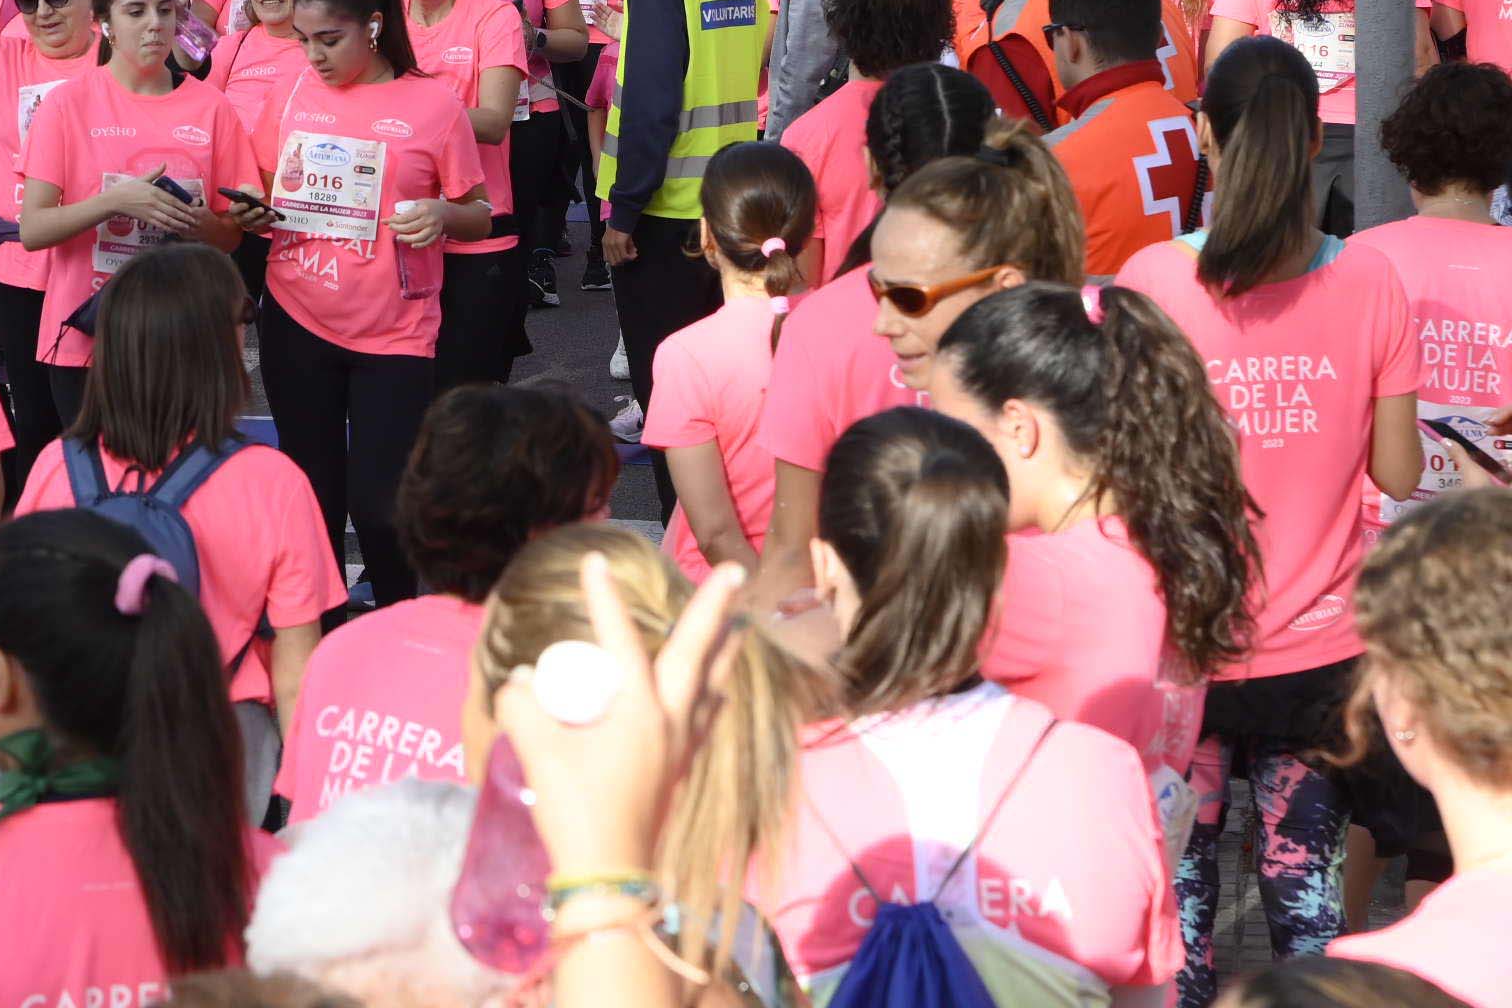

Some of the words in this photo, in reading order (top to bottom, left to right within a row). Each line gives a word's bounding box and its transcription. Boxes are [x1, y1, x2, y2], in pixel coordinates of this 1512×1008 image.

[702, 5, 756, 23] VOLUNTARIS
[90, 126, 137, 138] OYSHO
[307, 172, 343, 190] 016
[309, 192, 337, 203] 18289
[335, 221, 369, 232] Santander
[1414, 318, 1512, 348] ARRERA
[1423, 342, 1458, 366] DE
[1467, 345, 1497, 370] LA
[1206, 354, 1337, 386] CARRERA
[1229, 386, 1265, 410] DE
[1275, 383, 1312, 408] LA
[315, 704, 465, 776] CARRERA
[329, 741, 372, 777] DE
